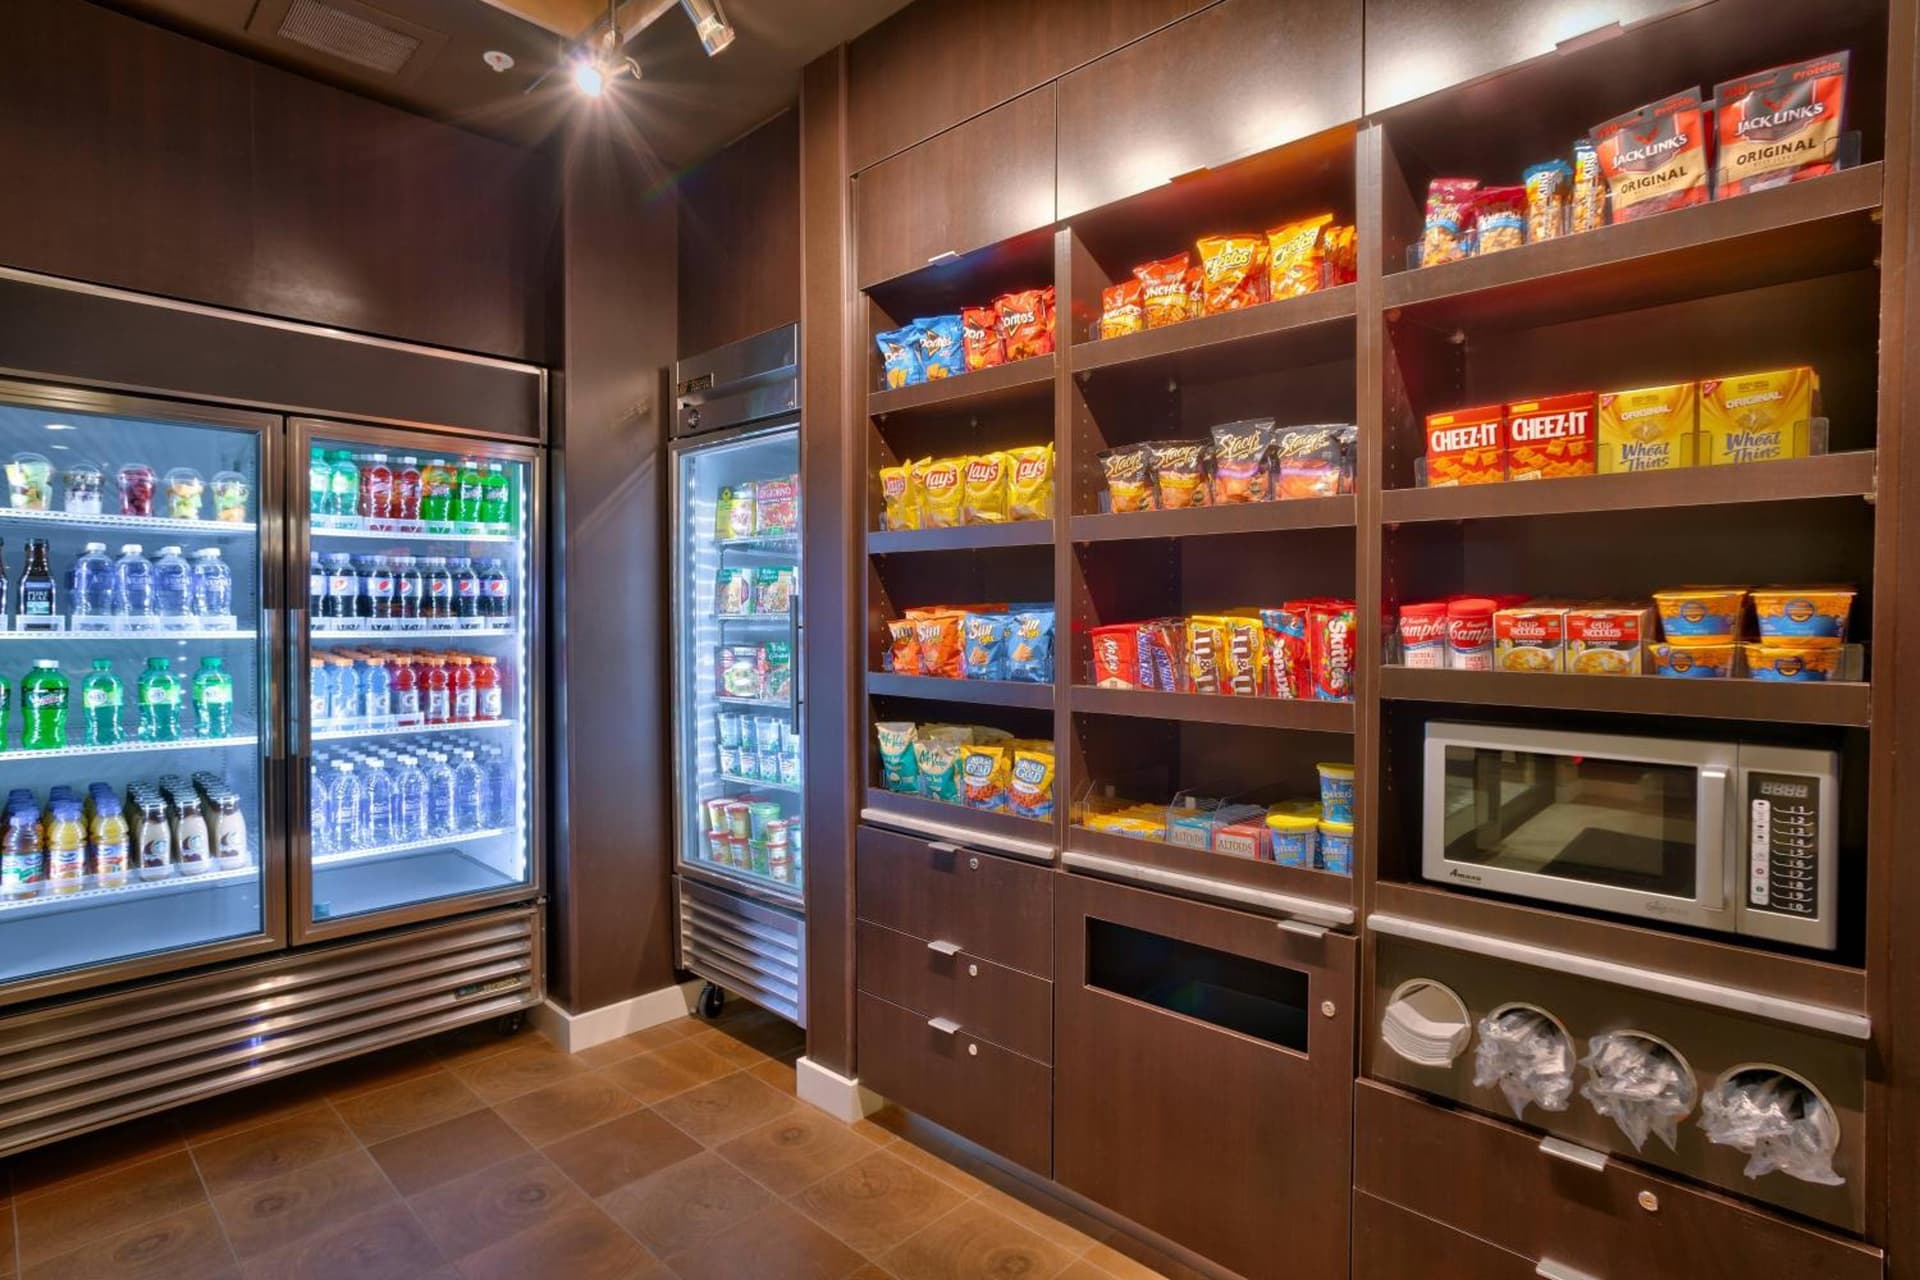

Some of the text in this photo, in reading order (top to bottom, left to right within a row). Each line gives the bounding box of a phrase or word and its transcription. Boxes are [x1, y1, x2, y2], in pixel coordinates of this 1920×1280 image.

[1735, 116, 1773, 136] JACK
[1612, 150, 1645, 169] JACK
[1736, 138, 1818, 166] ORIGINAL
[1620, 165, 1688, 195] ORIGINAL
[1511, 411, 1588, 441] CHEEZ-IT
[1430, 423, 1498, 453] CHEEZ-IT
[1726, 430, 1781, 451] Wheat
[1622, 440, 1670, 460] Wheat
[1722, 447, 1781, 464] Thins
[1619, 456, 1670, 472] Thins
[969, 619, 993, 639] Sun
[1328, 620, 1348, 689] Skittles
